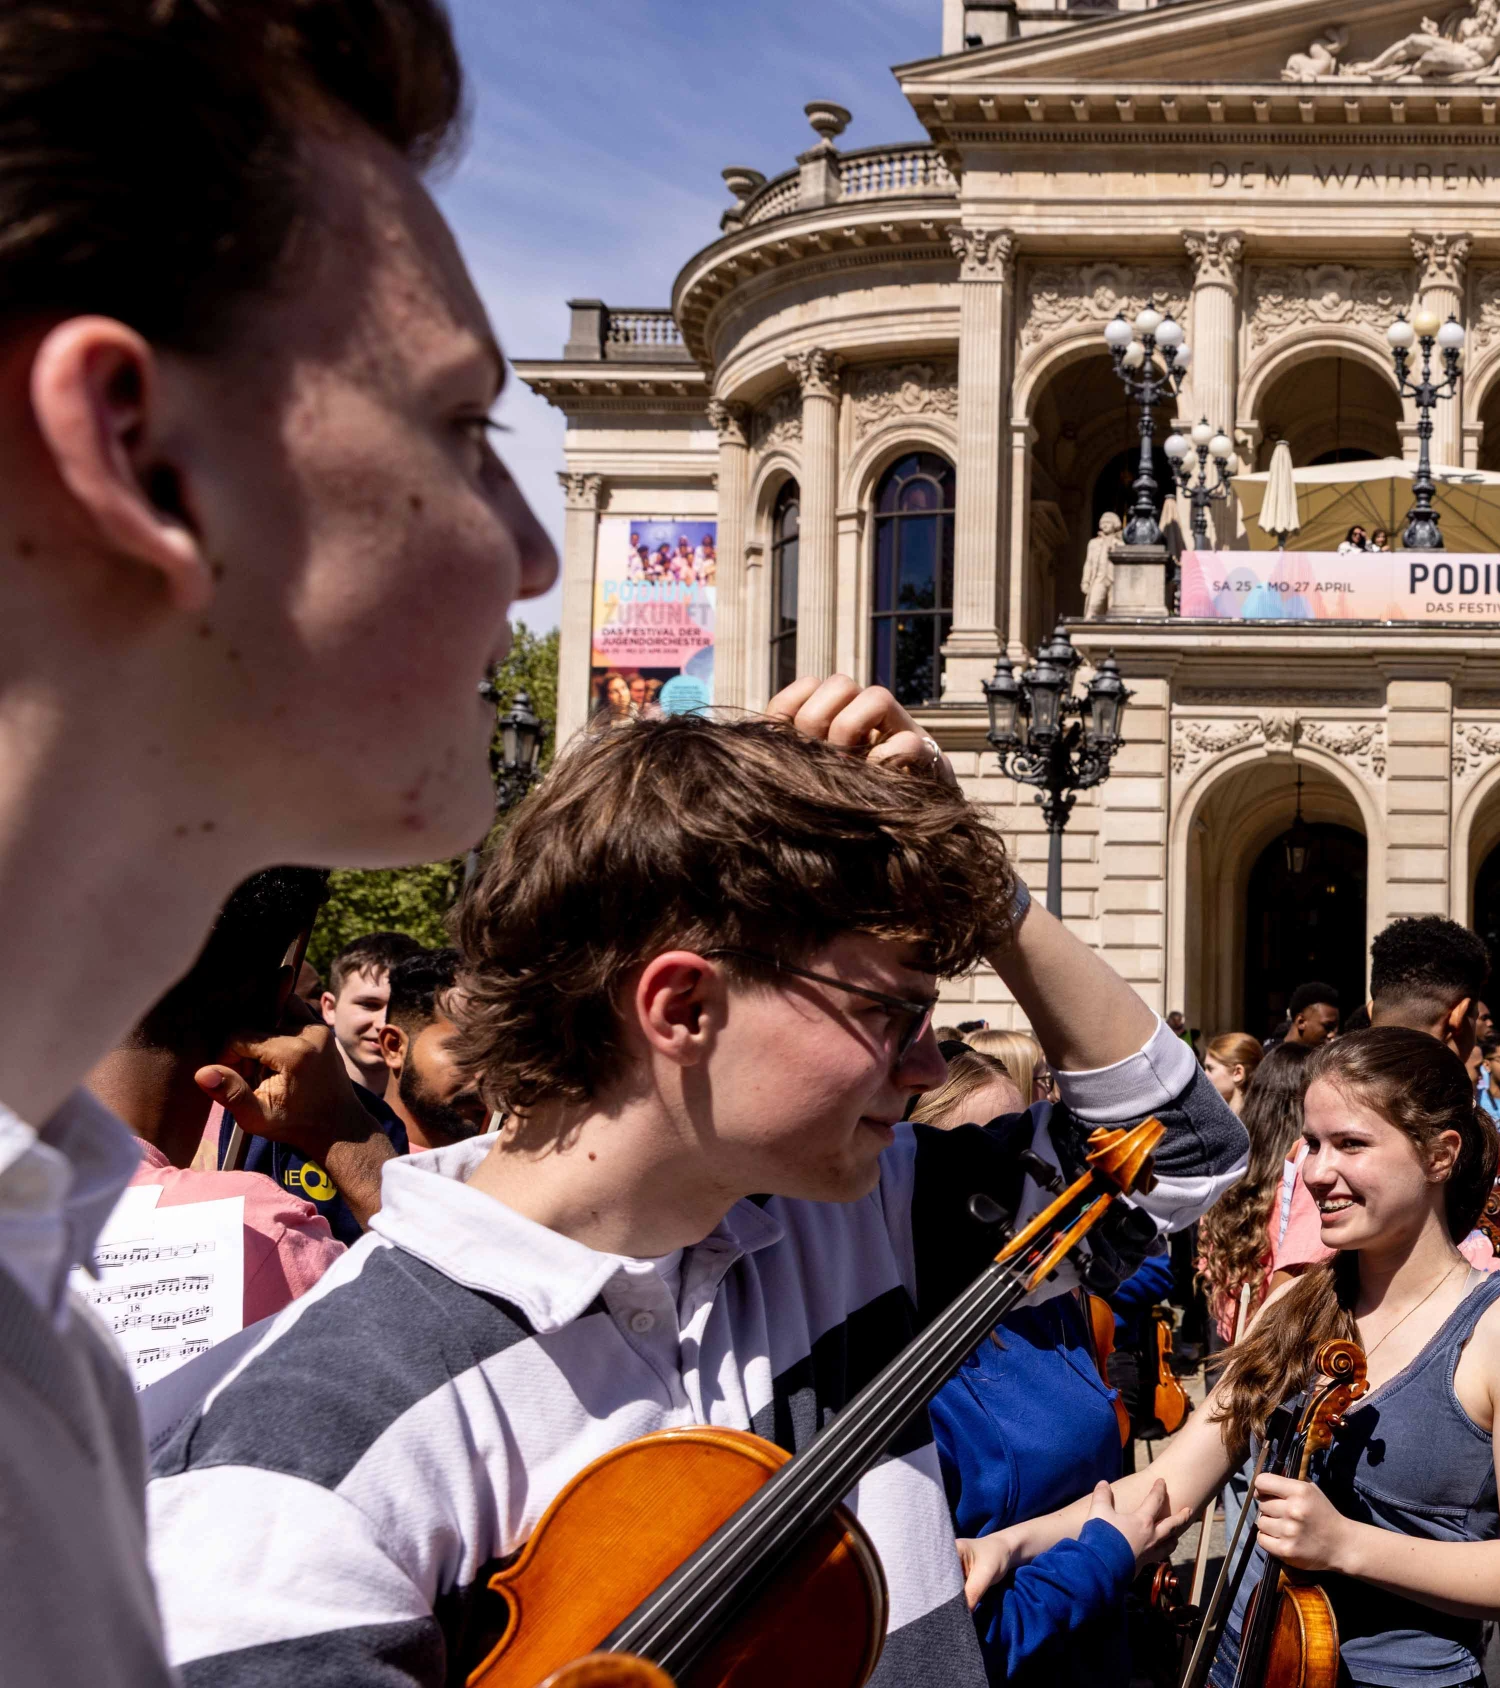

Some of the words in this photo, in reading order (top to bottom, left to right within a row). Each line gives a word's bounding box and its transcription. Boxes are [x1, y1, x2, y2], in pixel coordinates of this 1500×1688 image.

[1209, 161, 1290, 189] DEM
[1312, 163, 1487, 191] WAHREN
[603, 580, 699, 602] PODIUM
[1213, 580, 1232, 592] SA
[1236, 581, 1252, 593] 25
[1267, 581, 1290, 594] MO
[1294, 582, 1310, 593] 27
[1314, 582, 1356, 594] APRIL
[603, 603, 712, 625] ZUKUNFT
[1426, 602, 1454, 614] DAS
[601, 628, 624, 637] DAS
[625, 628, 675, 637] FESTIVAL
[678, 628, 702, 637] DER
[600, 637, 712, 647] JUGENDORCHESTER
[130, 1304, 141, 1313] 18
